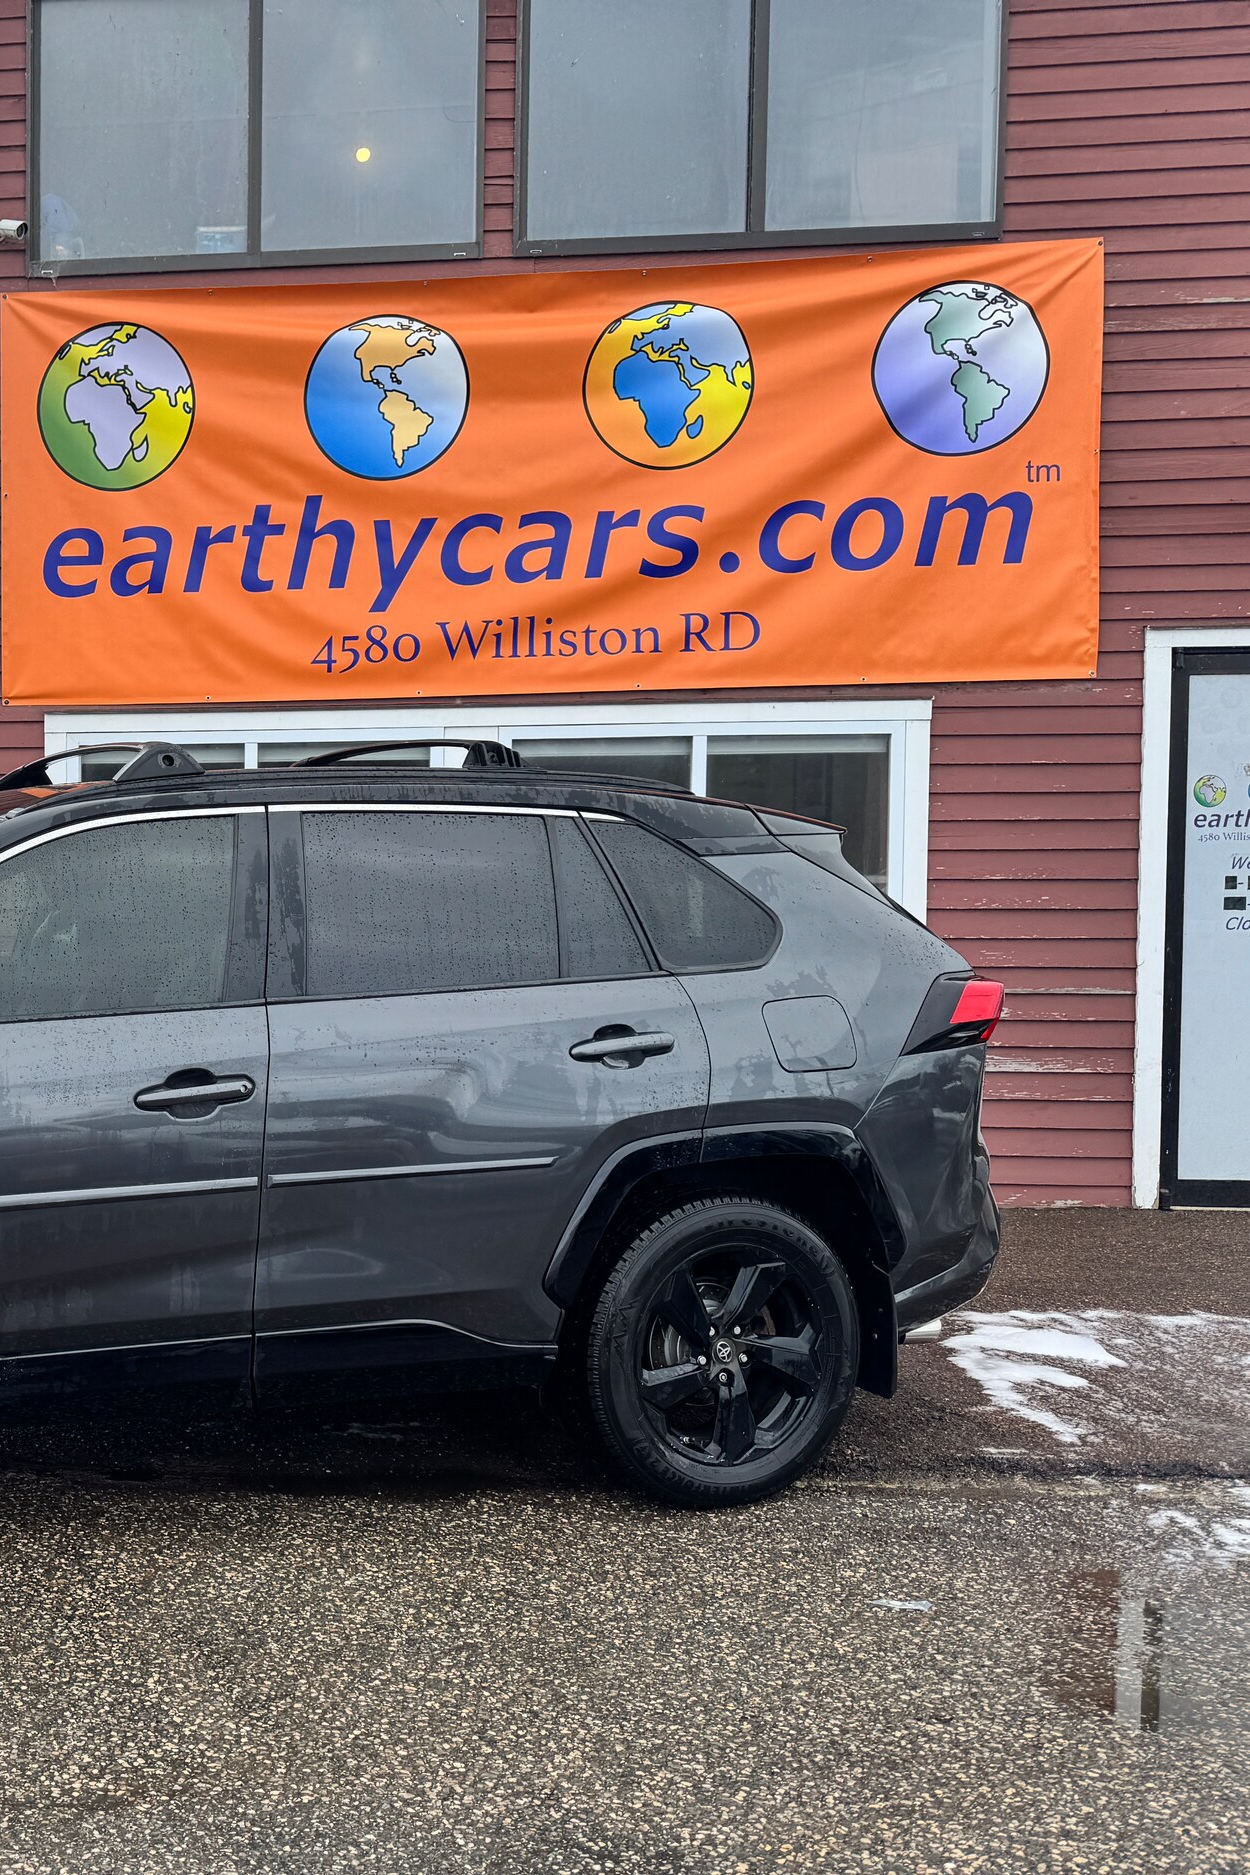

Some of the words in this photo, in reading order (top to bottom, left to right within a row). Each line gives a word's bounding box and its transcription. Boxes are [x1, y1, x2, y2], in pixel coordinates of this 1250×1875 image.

[1025, 460, 1063, 482] tm
[43, 491, 1034, 614] earthycars.com
[310, 625, 420, 674] 4580
[435, 614, 661, 662] Williston
[679, 612, 761, 654] RD
[1197, 833, 1220, 842] 4580
